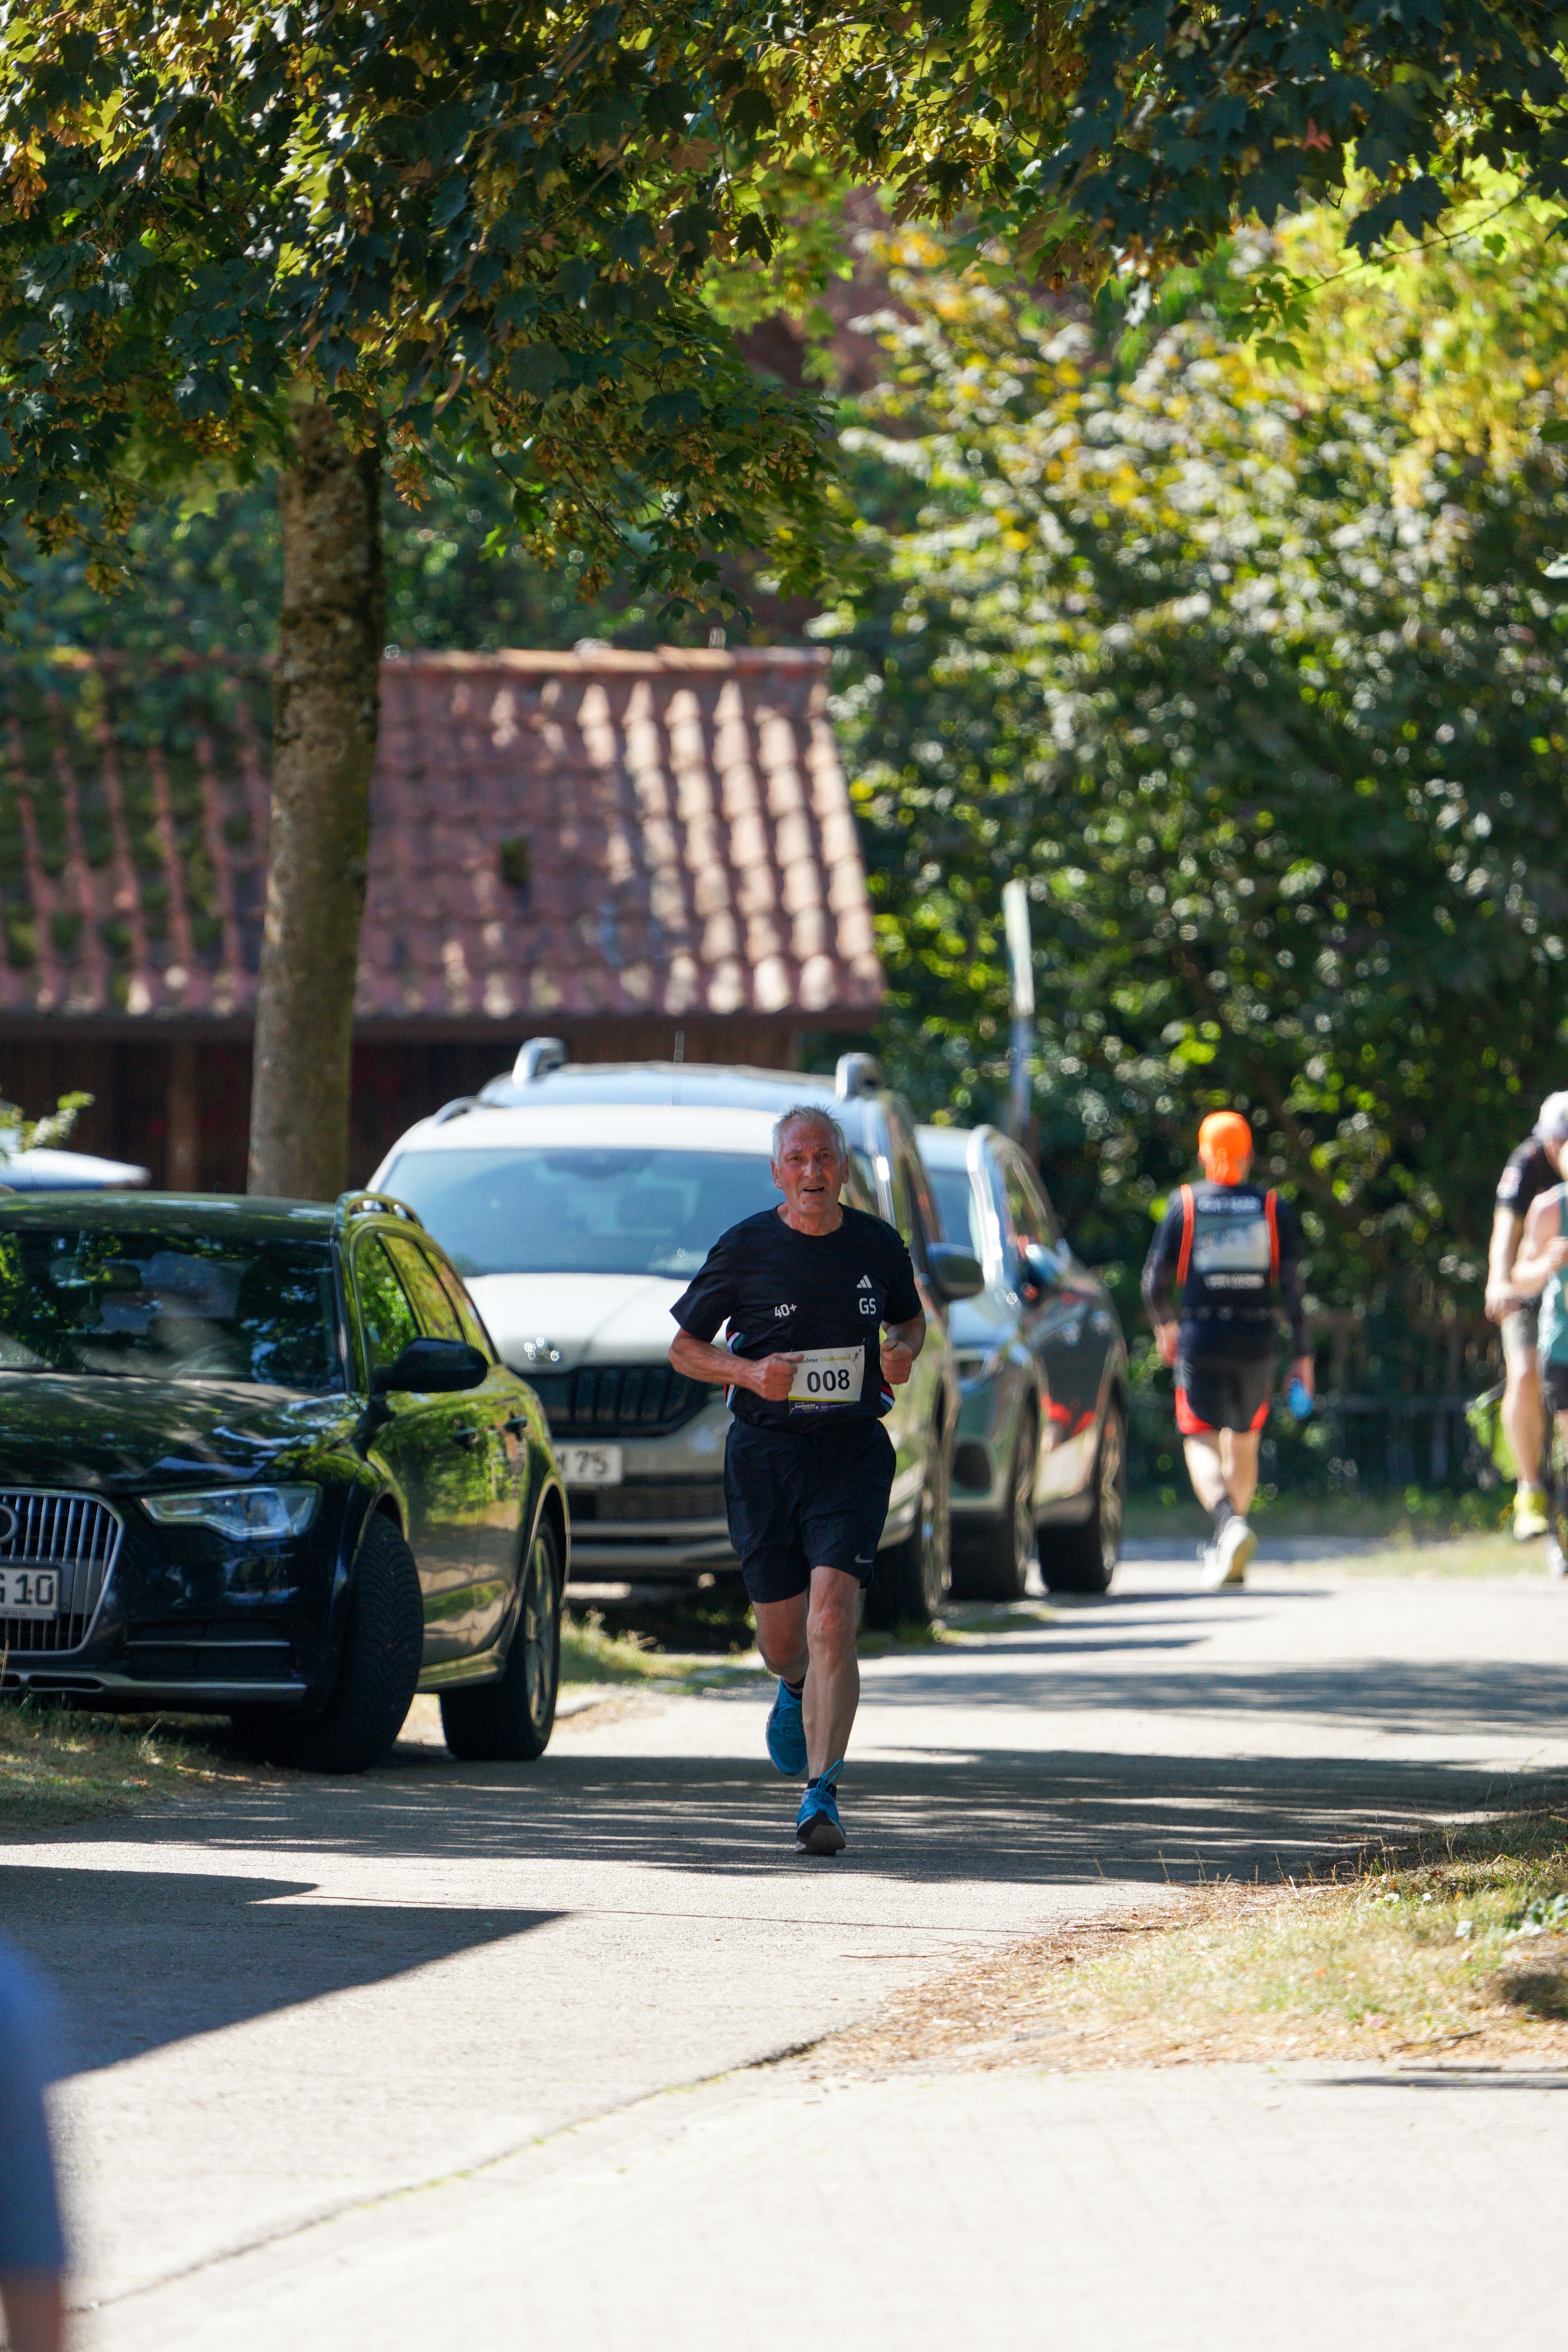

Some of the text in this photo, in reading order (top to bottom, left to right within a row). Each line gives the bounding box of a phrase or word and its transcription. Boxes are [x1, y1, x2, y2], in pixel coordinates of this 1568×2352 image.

[774, 1303, 797, 1318] 40+
[859, 1298, 876, 1315] GS
[807, 1369, 850, 1393] 008
[14, 1573, 53, 1605] 10
